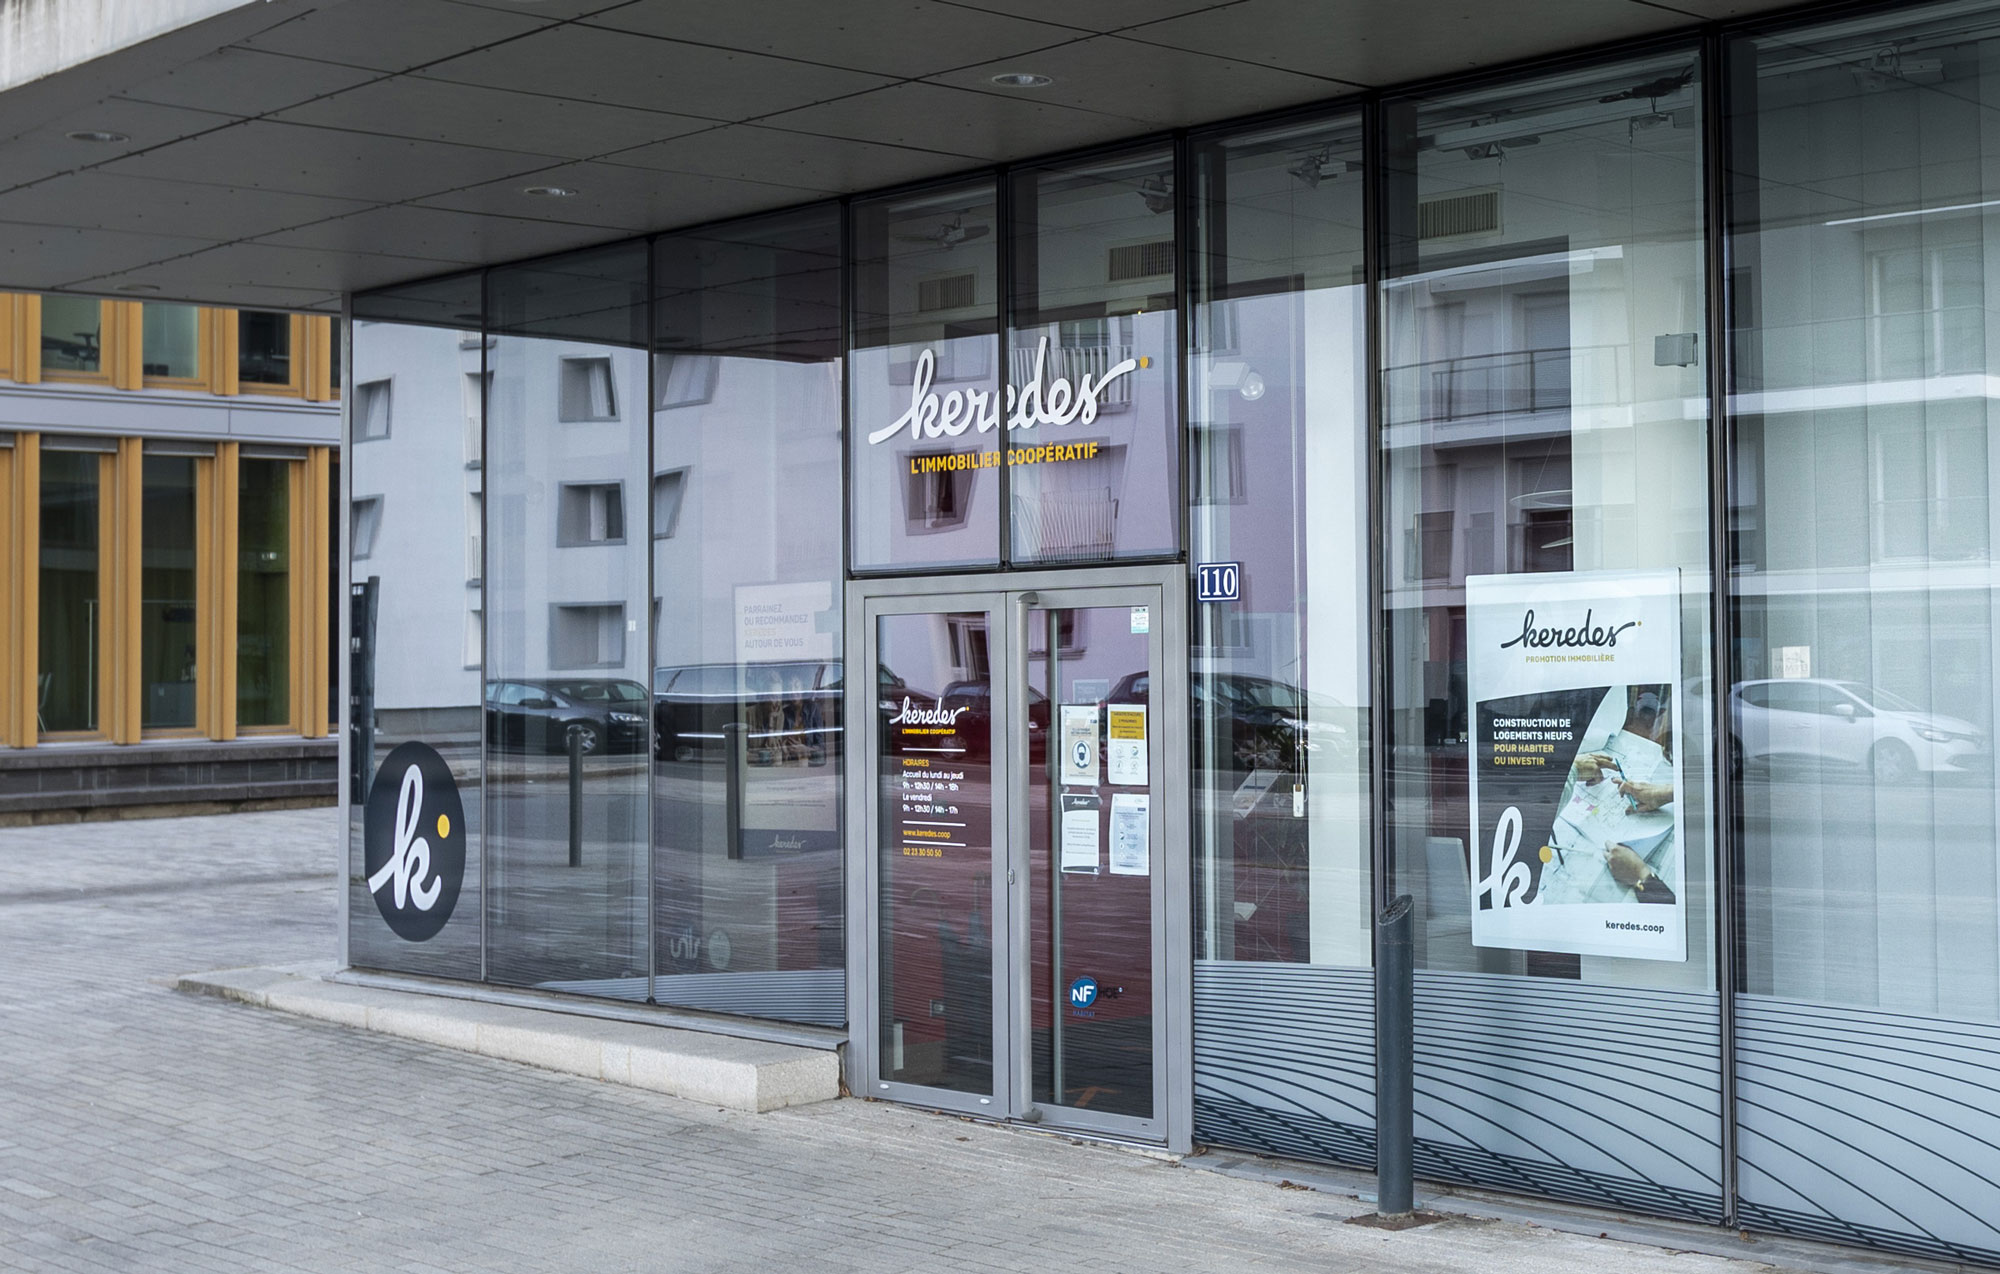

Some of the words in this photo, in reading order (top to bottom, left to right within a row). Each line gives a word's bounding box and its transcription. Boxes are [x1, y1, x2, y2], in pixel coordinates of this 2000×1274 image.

[868, 336, 1137, 444] keredes
[1007, 442, 1099, 466] COOPÉRATIF
[1201, 568, 1236, 596] 110
[744, 604, 783, 614] PARRAINEZ
[744, 616, 754, 626] OU
[755, 614, 809, 625] RECOMMANDEZ
[1501, 609, 1636, 649] keredes
[745, 639, 773, 648] AUTOUR
[773, 638, 783, 648] DE
[784, 637, 804, 647] VOUS
[1526, 655, 1567, 664] PROMOTION
[1568, 653, 1616, 663] IMMOBILIÈRE
[889, 696, 966, 725] keredes
[1493, 718, 1558, 728] CONSTRUCTION
[1559, 719, 1571, 728] DE
[1494, 731, 1543, 741] LOGEMENTS
[1544, 731, 1573, 741] NEUFS
[1494, 744, 1517, 753] POUR
[1518, 744, 1554, 753] HABITER
[902, 759, 930, 767] HORAIRES
[1494, 757, 1506, 765] OU
[1507, 757, 1545, 766] INVESTIR
[902, 770, 921, 778] Accueil
[922, 771, 929, 779] du
[902, 793, 909, 801] Le
[910, 793, 932, 802] vendredi
[367, 764, 442, 912] k
[903, 829, 951, 839] www.keredes.coop
[903, 847, 910, 856] 02
[1605, 920, 1665, 934] keredes.coop
[1072, 985, 1095, 1002] NF
